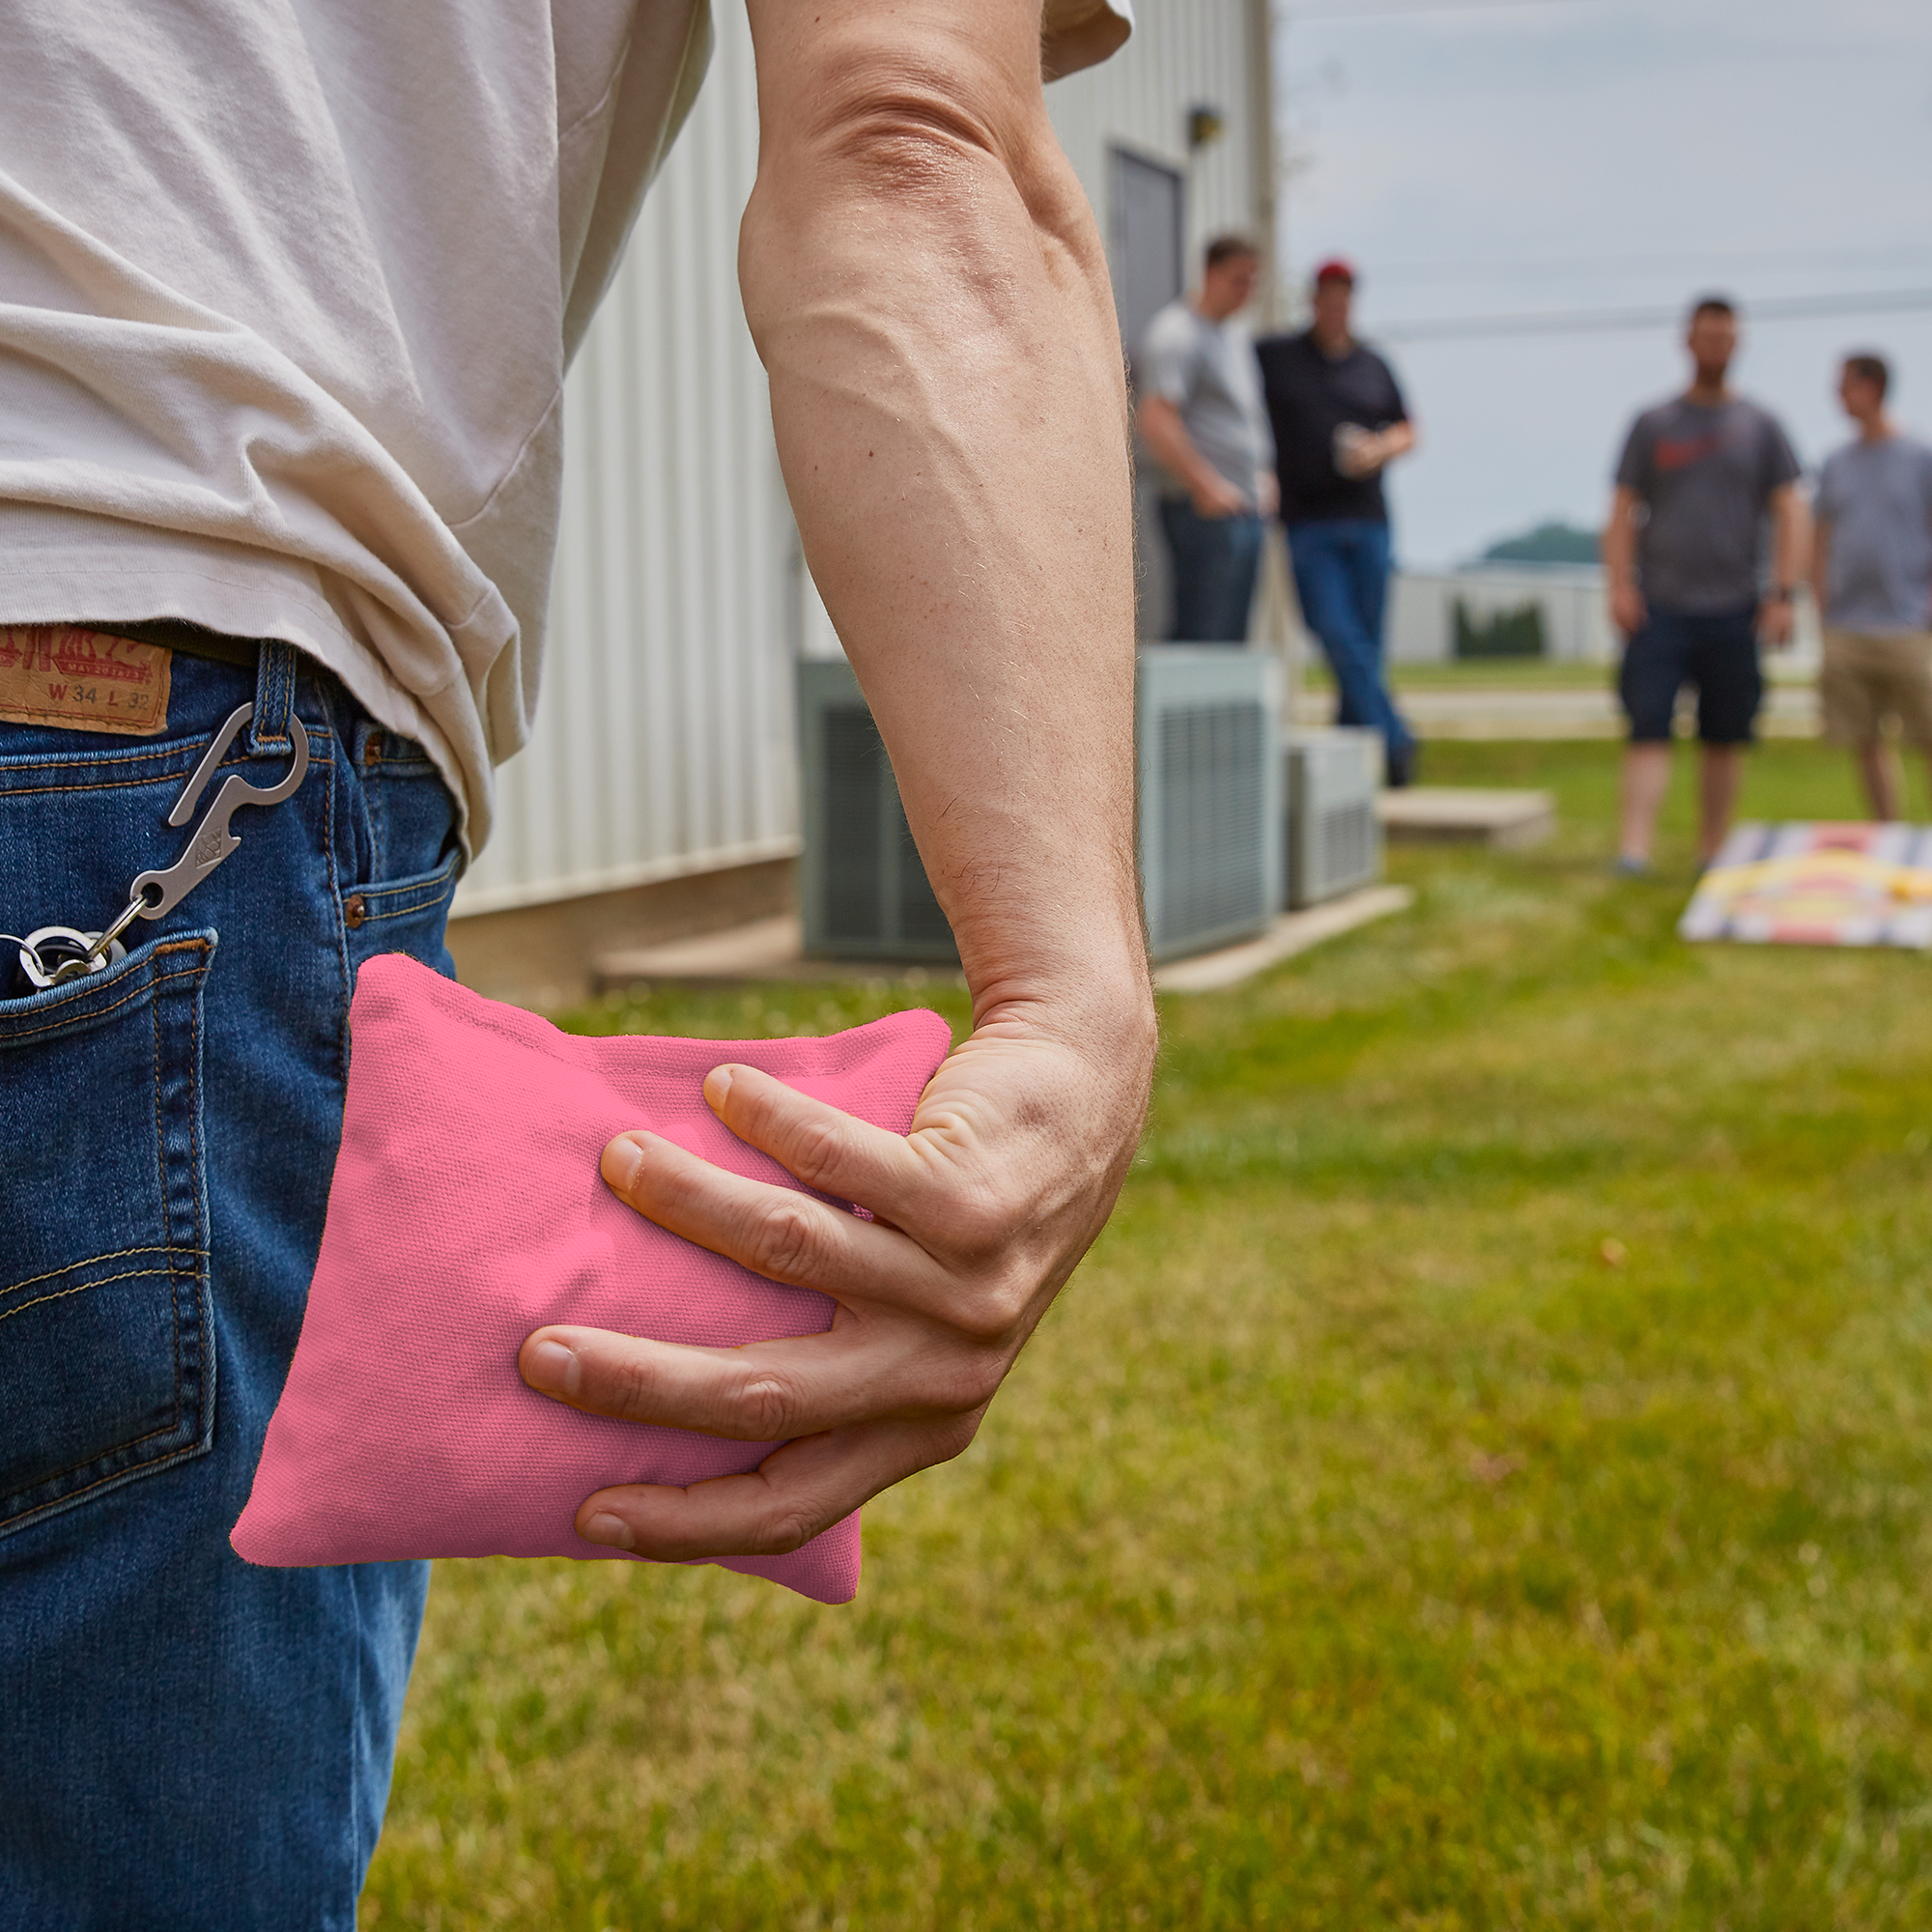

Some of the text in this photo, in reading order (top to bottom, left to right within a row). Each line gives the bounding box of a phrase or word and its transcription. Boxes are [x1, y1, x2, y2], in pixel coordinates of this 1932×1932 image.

[48, 683, 150, 711] W 34 L 32
